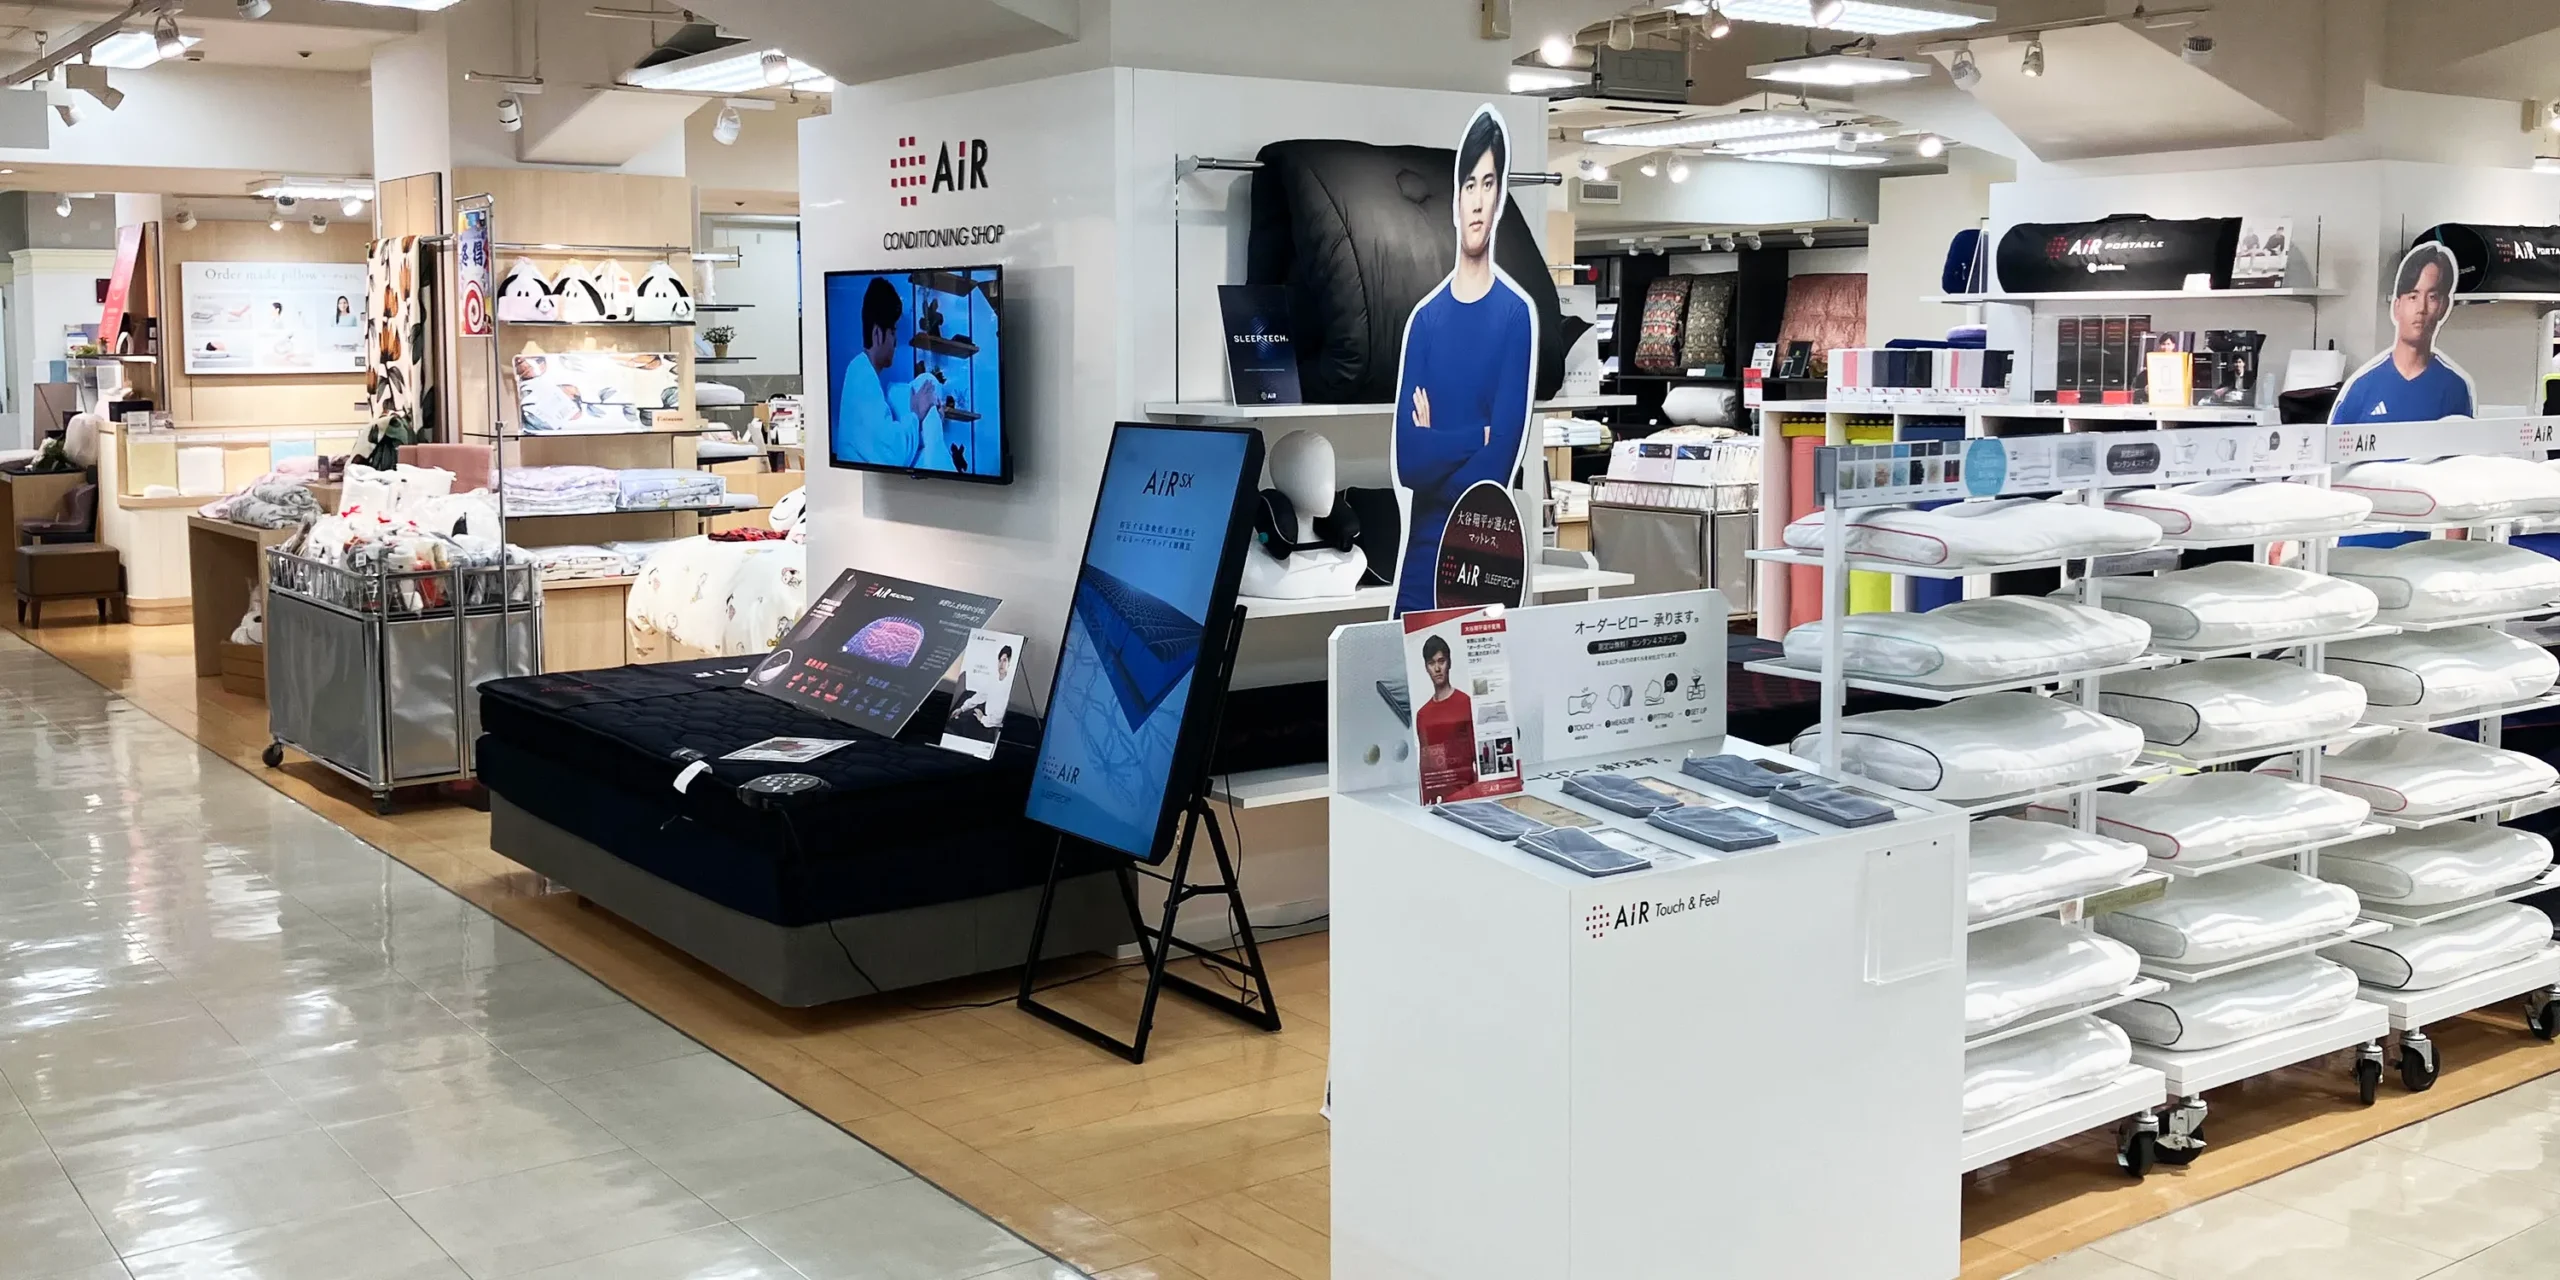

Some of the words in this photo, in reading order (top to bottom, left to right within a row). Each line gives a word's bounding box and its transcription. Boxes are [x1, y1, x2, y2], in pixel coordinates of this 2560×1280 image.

[883, 227, 969, 251] CONDITIONING
[971, 224, 1005, 245] SHOP
[2104, 240, 2165, 250] PORTABLE
[205, 267, 241, 280] Order
[281, 267, 317, 283] pillow
[1457, 510, 1517, 533] 大谷翔平が選んだ
[1574, 615, 1649, 635] オーダーピロー
[1653, 610, 1700, 627] 承ります。
[1574, 722, 1595, 732] TOUCH
[1655, 897, 1685, 917] Touch
[1687, 896, 1696, 910] &
[1699, 889, 1721, 908] Feel
